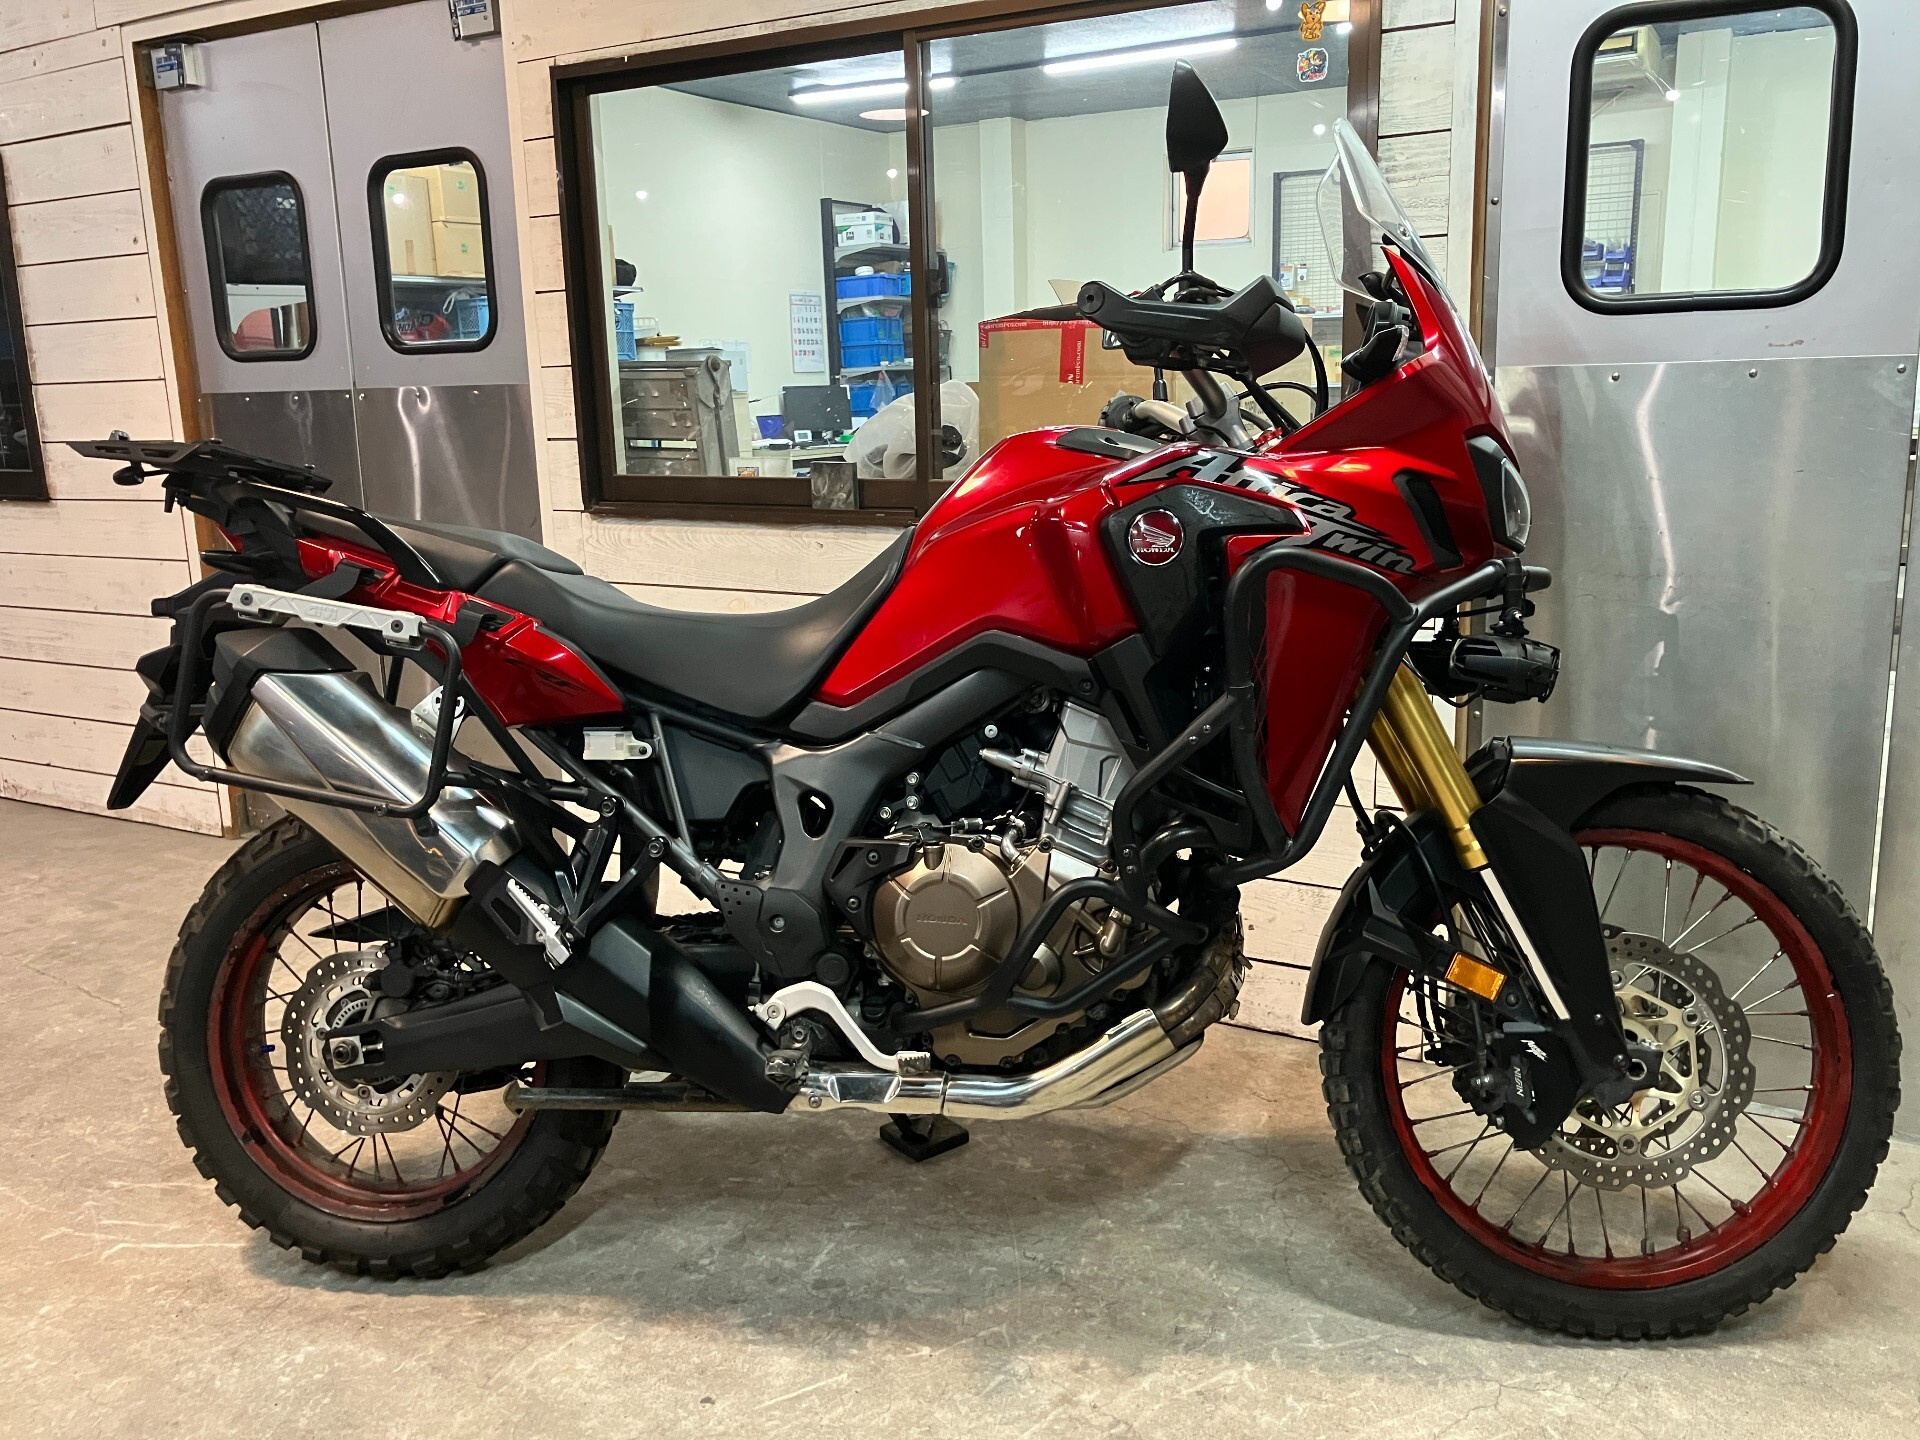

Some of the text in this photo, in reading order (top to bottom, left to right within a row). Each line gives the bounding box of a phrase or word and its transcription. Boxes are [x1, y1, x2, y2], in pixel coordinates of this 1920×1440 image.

[1129, 450, 1352, 520] Africa
[1263, 513, 1413, 574] Twin
[917, 913, 968, 926] HONDA
